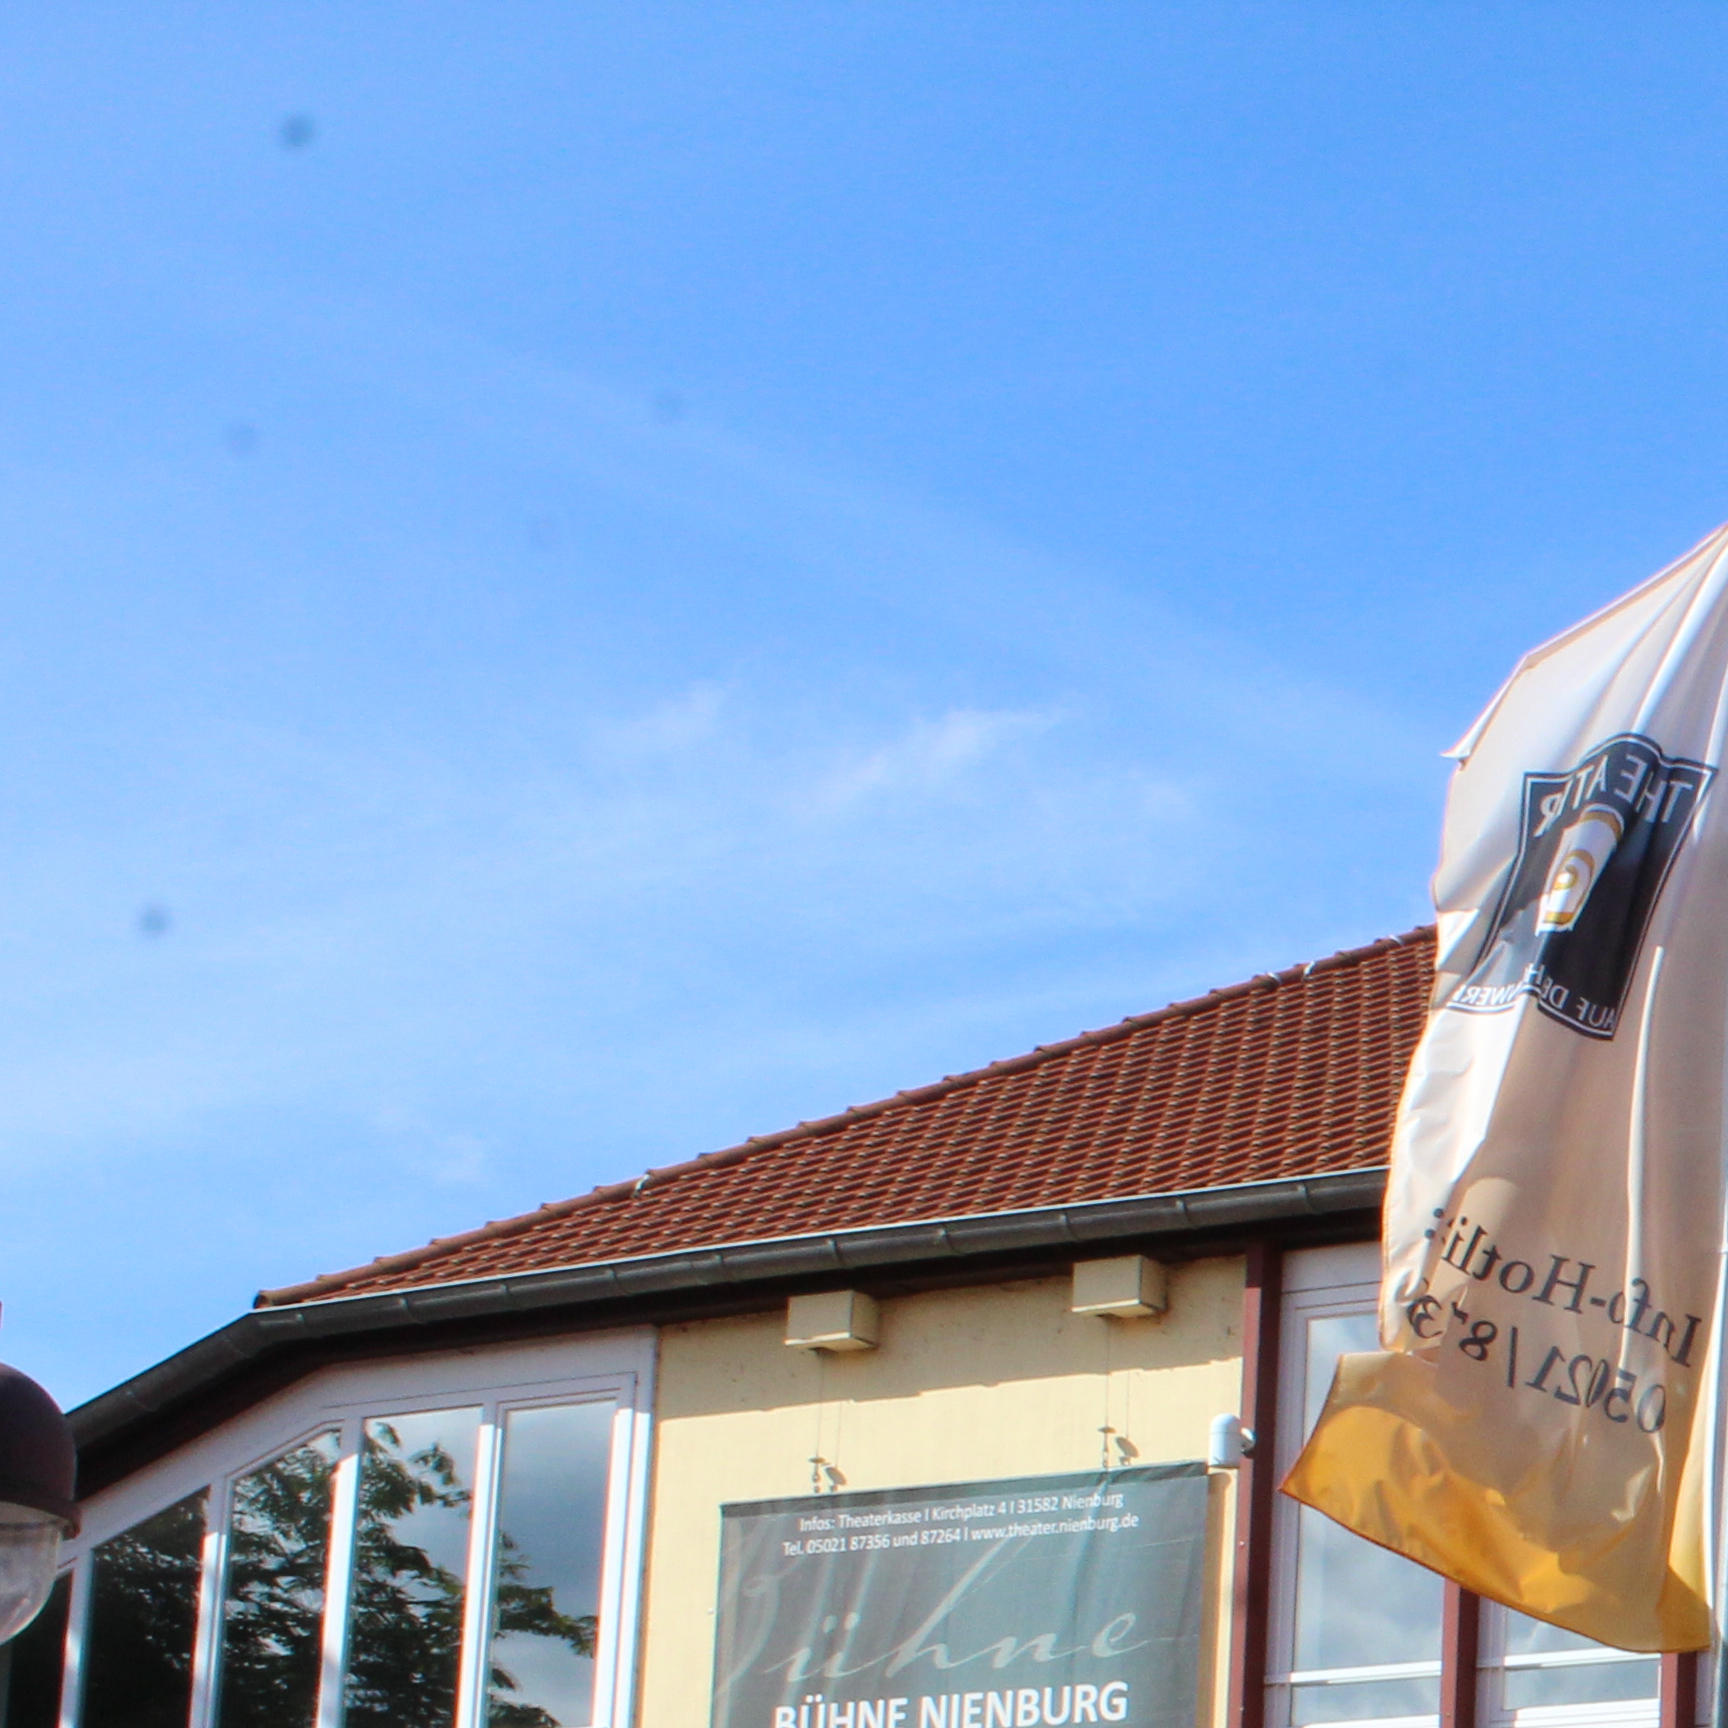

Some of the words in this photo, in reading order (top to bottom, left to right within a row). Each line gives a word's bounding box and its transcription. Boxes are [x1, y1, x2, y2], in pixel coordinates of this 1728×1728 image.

[799, 1516, 835, 1533] Infos:
[838, 1510, 922, 1529] Theaterkasse
[931, 1504, 995, 1521] Kirchplatz
[997, 1500, 1007, 1514] 4
[1016, 1496, 1059, 1514] 31582
[1062, 1492, 1124, 1510] Nienburg
[782, 1540, 804, 1557] Tel.
[806, 1537, 848, 1555] 05021
[850, 1533, 891, 1552] 87356
[892, 1531, 919, 1548] und
[920, 1527, 961, 1546] 87264
[971, 1512, 1140, 1541] www.theater.nienburg.de
